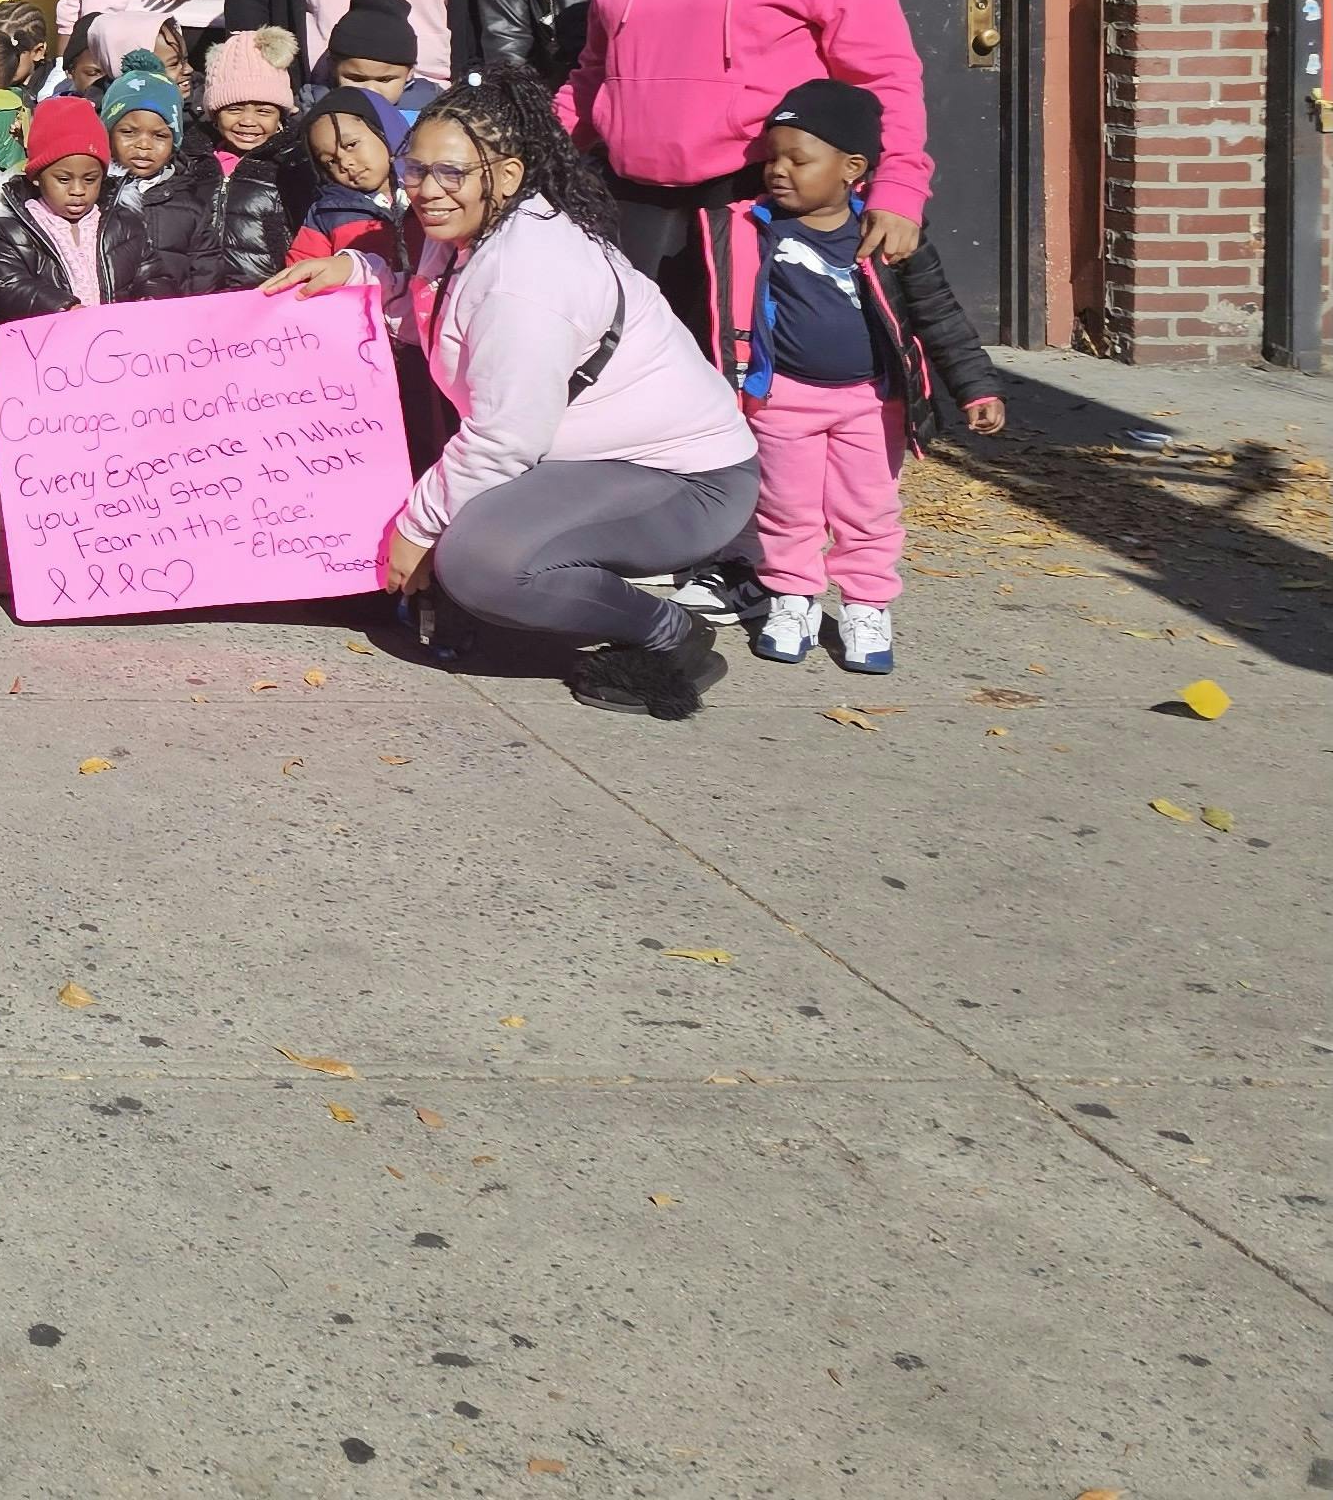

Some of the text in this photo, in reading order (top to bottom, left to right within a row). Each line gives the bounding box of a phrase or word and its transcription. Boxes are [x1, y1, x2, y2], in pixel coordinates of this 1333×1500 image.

[84, 328, 186, 385] Gain
[186, 325, 321, 368] Strength
[131, 401, 175, 429] and
[182, 381, 316, 423] Confidence
[322, 375, 358, 411] by
[14, 417, 385, 501] Every Experience in Which
[25, 447, 366, 547] you really Stop to look
[73, 525, 143, 560] Fear
[150, 524, 178, 545] in
[182, 507, 242, 539] the
[305, 551, 391, 573] Roosev
